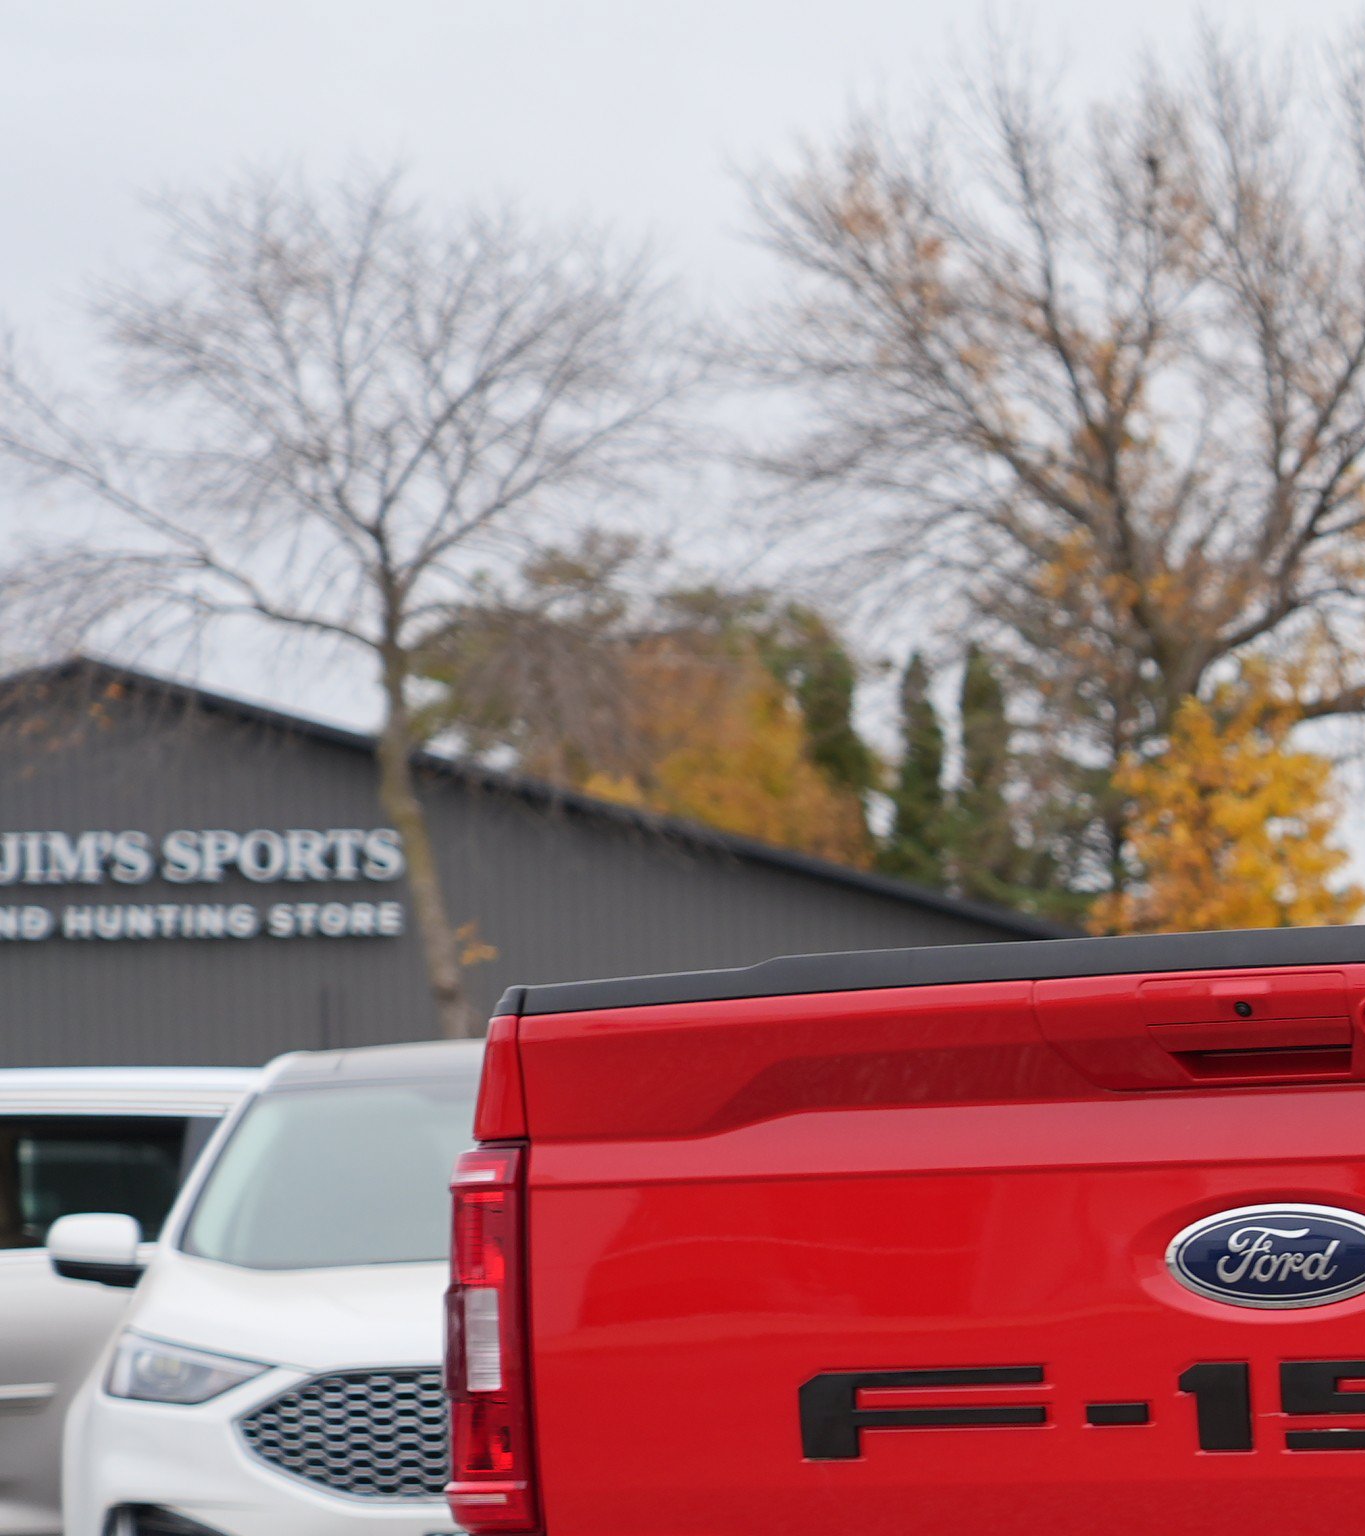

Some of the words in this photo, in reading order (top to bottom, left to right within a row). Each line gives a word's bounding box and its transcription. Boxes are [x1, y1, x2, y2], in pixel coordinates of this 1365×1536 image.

[0, 830, 153, 885] JIM'S
[162, 827, 405, 882] SPORTS
[62, 902, 260, 940] HUNTING
[267, 900, 402, 937] STORE
[1217, 1226, 1338, 1284] Ford
